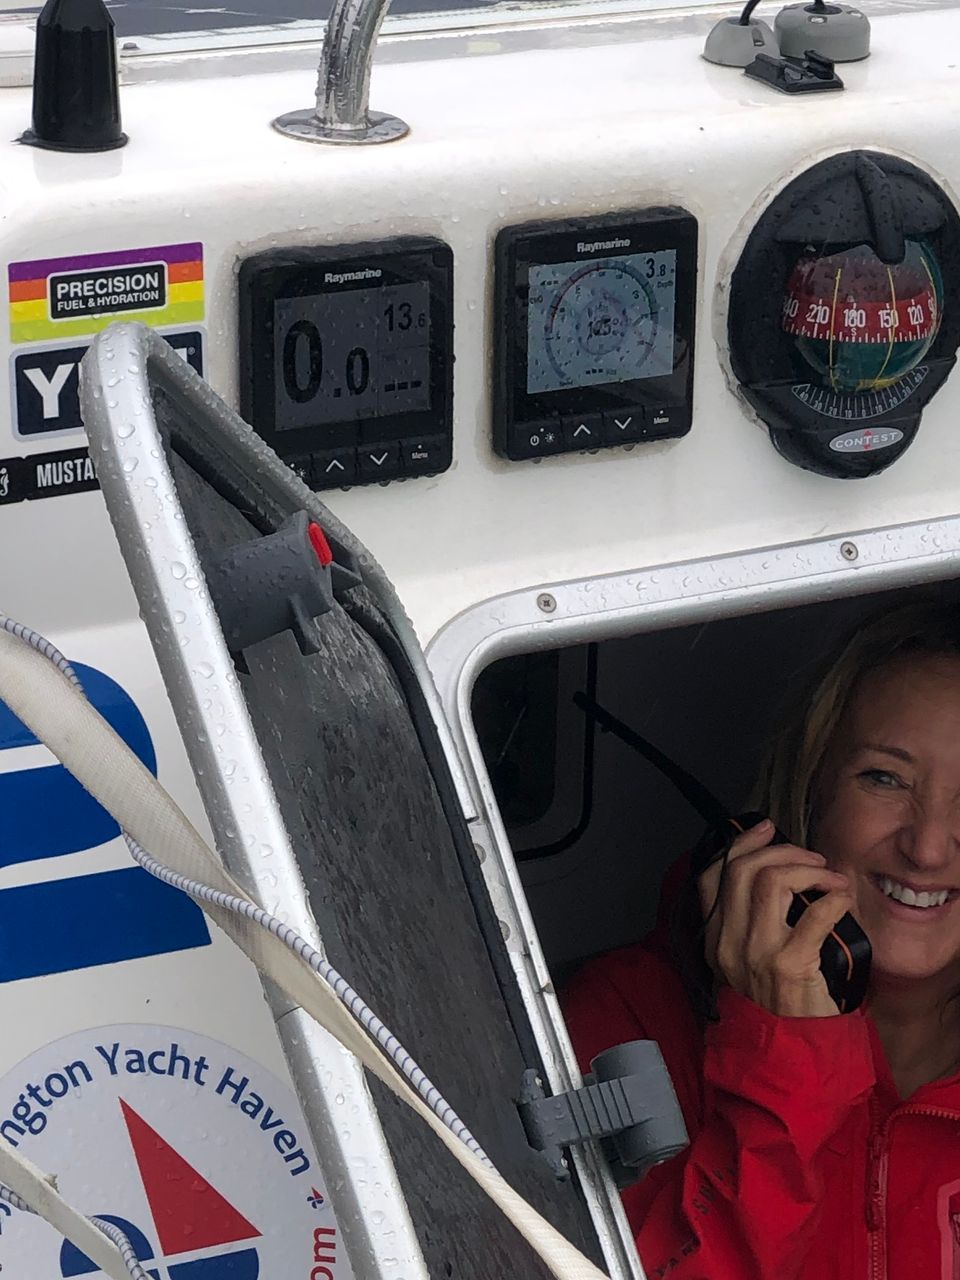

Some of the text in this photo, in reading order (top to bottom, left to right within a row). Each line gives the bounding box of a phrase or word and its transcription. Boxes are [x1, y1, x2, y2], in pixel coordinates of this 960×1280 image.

[576, 238, 631, 253] Raymarine
[56, 272, 159, 299] PRECISION
[324, 268, 382, 284] Raymarine
[57, 290, 159, 312] FUEL & HYDRATION
[806, 303, 830, 325] 210
[843, 308, 867, 328] 180
[878, 308, 898, 329] 150
[907, 304, 924, 326] 120
[835, 431, 898, 449] CONTEST
[37, 457, 98, 488] MUSTA
[94, 1041, 210, 1086] Yacht
[215, 1066, 312, 1177] Haven
